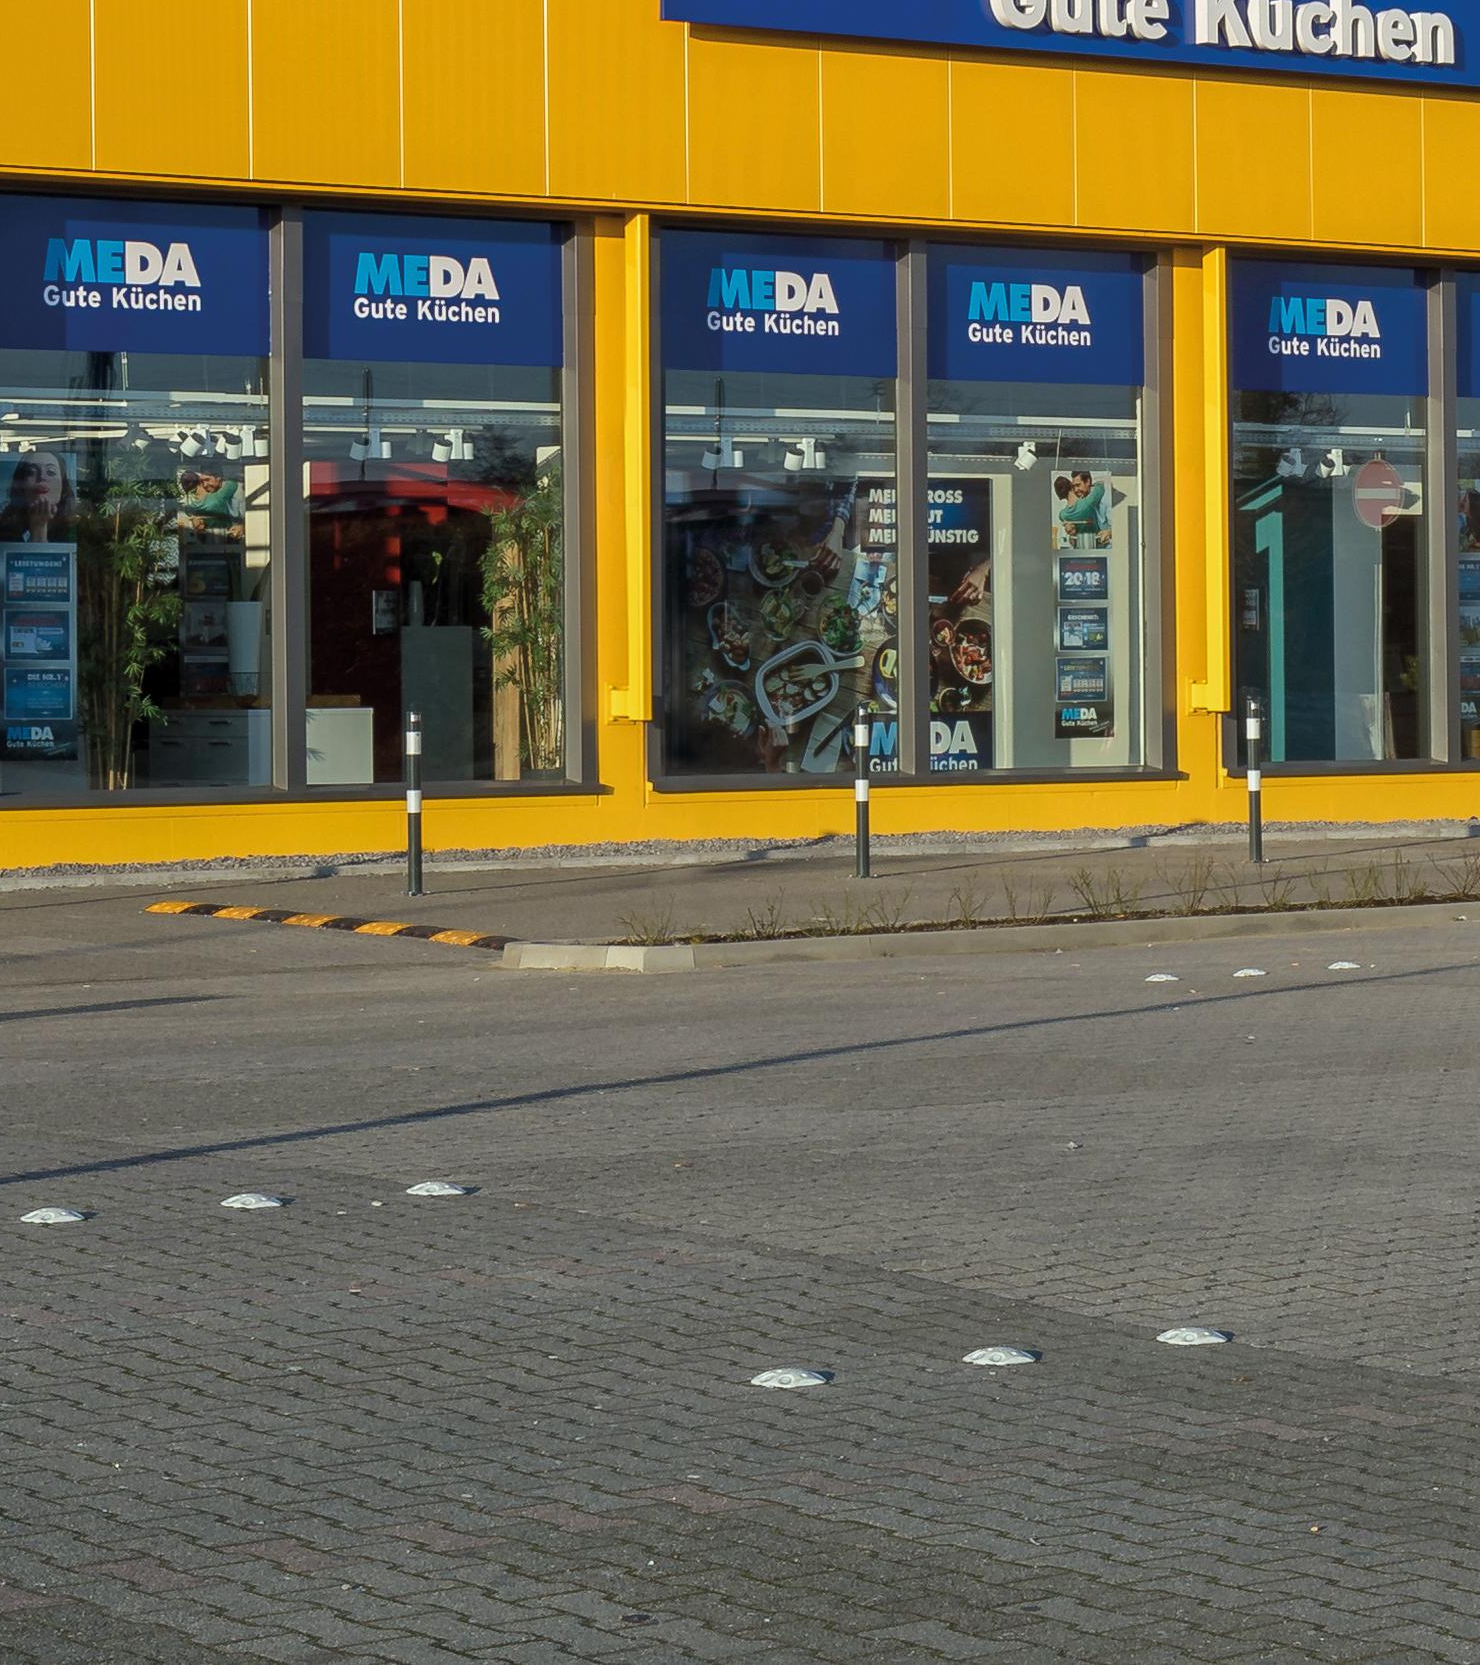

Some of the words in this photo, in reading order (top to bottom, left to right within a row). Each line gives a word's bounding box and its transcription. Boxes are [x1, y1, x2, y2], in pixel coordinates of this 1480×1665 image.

[43, 238, 201, 288] MEDA
[353, 252, 500, 300] MEDA
[43, 284, 101, 309] Gute
[112, 285, 201, 312] Küchen
[707, 267, 839, 315] MEDA
[967, 281, 1091, 325] MEDA
[353, 296, 407, 320] Gute
[417, 297, 500, 323] Küchen
[707, 310, 756, 334] Gute
[764, 312, 840, 337] Küchen
[1268, 296, 1380, 339] MEDA
[967, 322, 1013, 344] Gute
[1021, 325, 1091, 347] Küchen
[1268, 335, 1310, 356] Gute
[1316, 337, 1381, 359] Küchen
[1061, 707, 1098, 720] MEDA
[8, 726, 55, 741] MEDA
[869, 721, 978, 755] MDA
